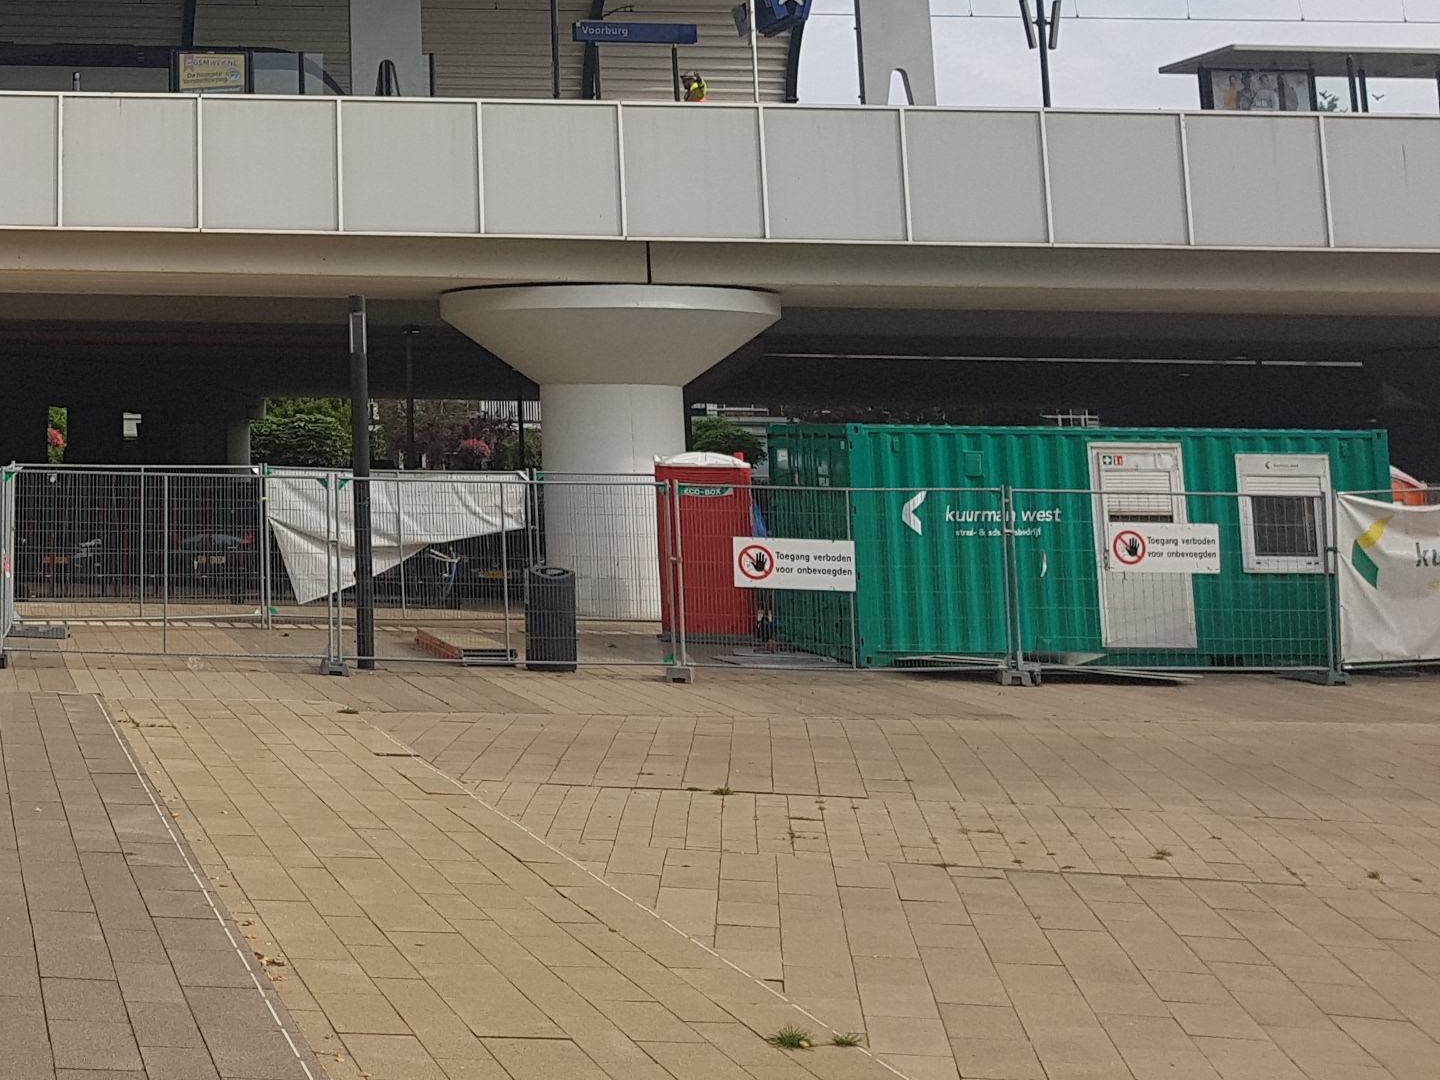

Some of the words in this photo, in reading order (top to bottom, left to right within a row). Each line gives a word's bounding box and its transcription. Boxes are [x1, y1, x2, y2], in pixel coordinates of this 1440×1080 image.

[582, 26, 628, 37] Voorburg
[945, 505, 1016, 522] kuurman
[1021, 508, 1062, 522] west
[1147, 537, 1179, 546] Toegang
[1181, 537, 1216, 545] verboden
[775, 551, 810, 562] Toegang
[813, 553, 852, 562] verboden
[1166, 551, 1217, 559] onbevoegden
[797, 566, 853, 577] onbevoegden
